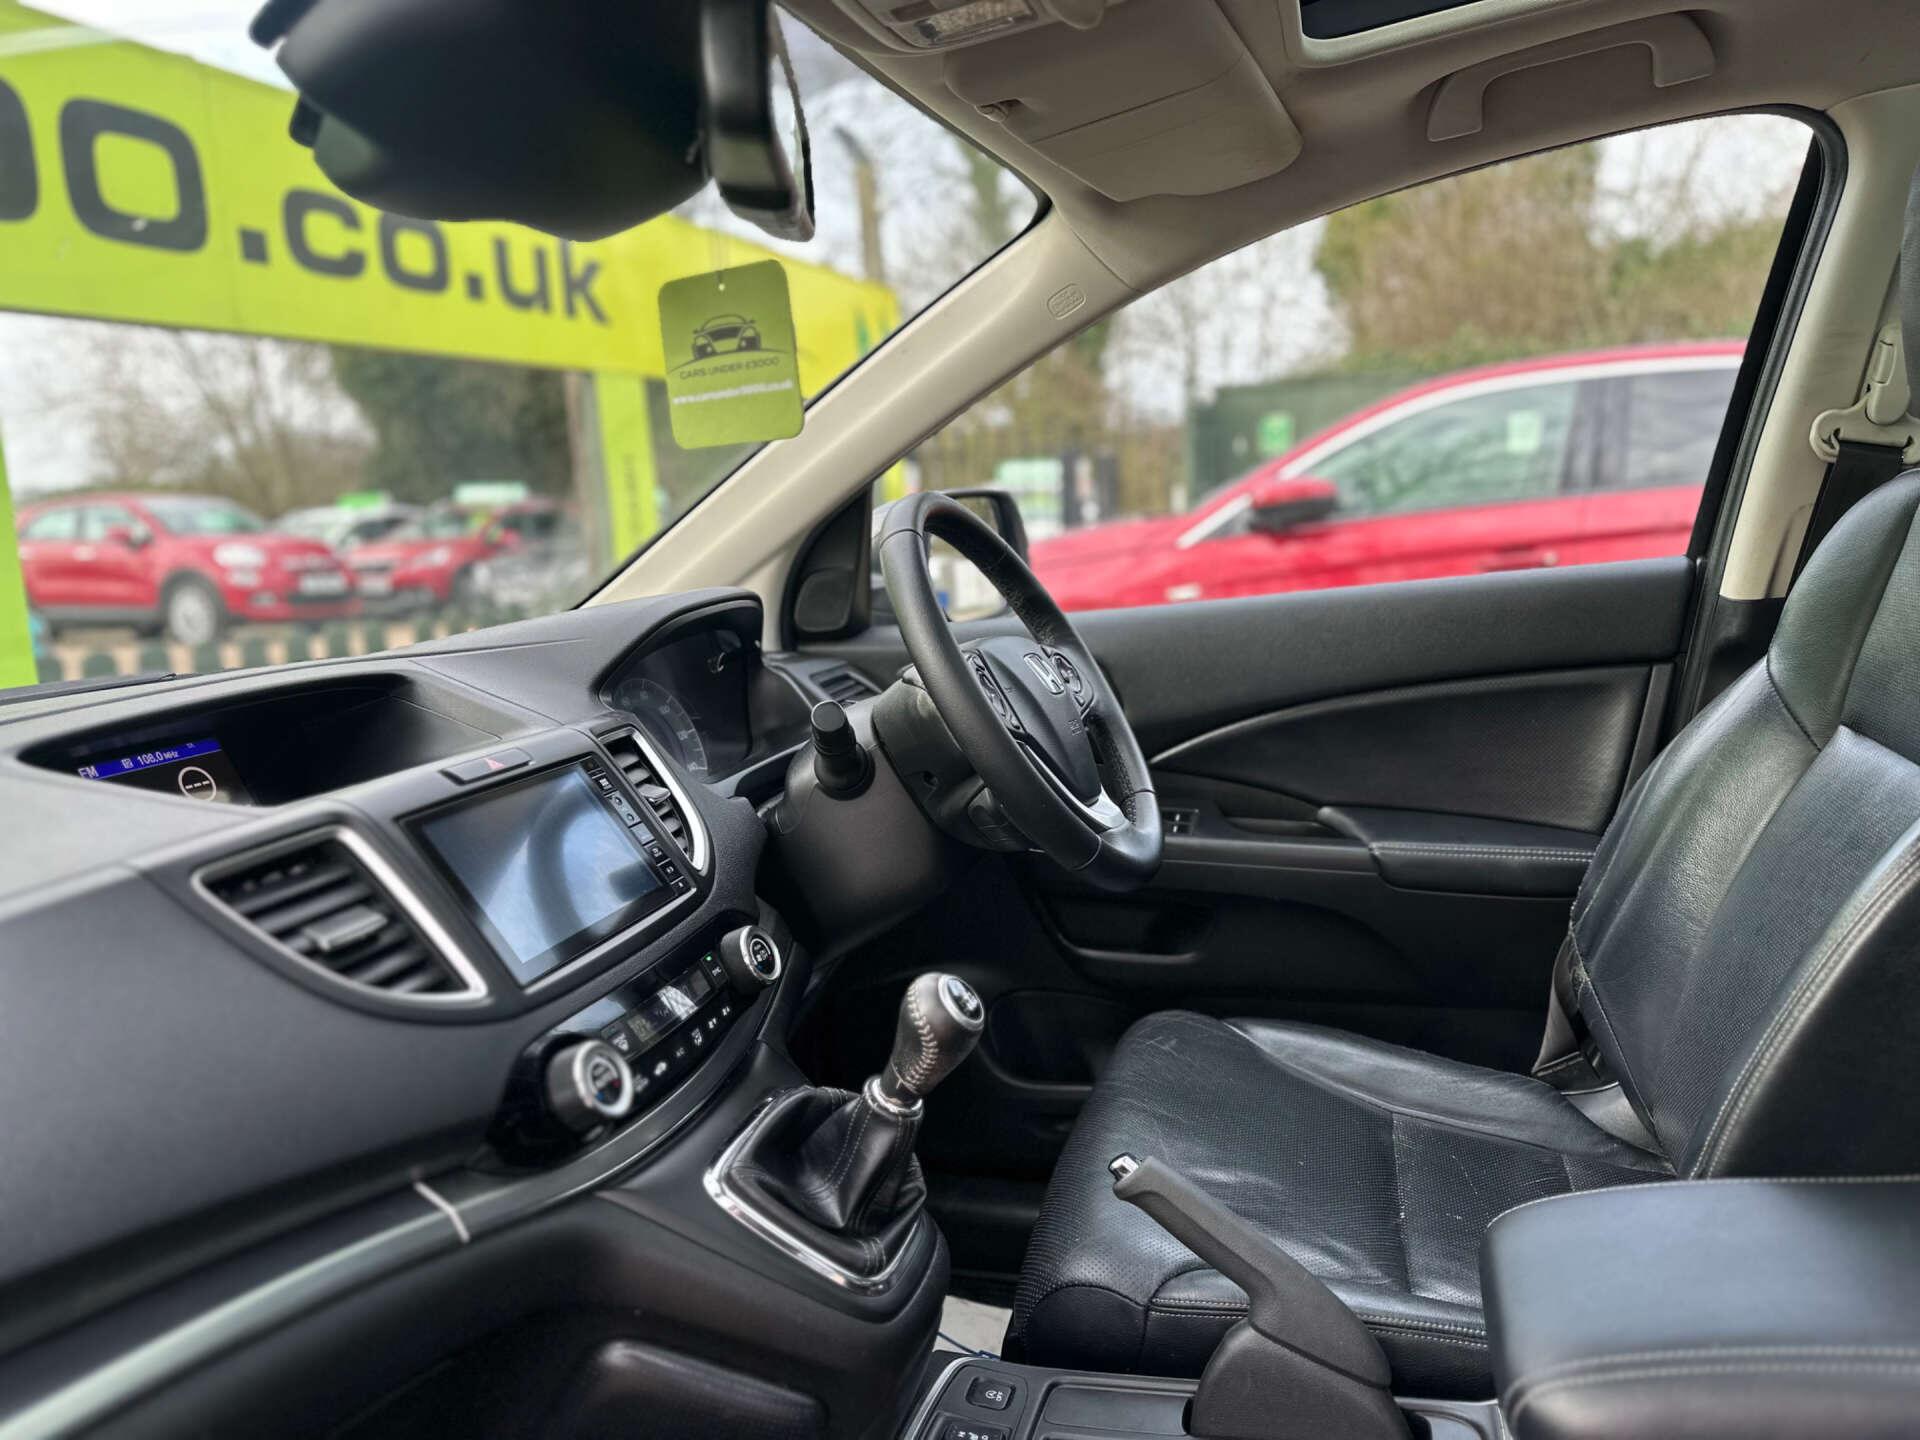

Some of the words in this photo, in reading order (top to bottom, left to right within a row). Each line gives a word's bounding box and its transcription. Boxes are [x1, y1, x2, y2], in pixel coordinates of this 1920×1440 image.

[680, 367, 705, 380] CARS
[708, 363, 744, 376] UNDER
[78, 766, 98, 779] FM
[137, 752, 163, 766] 108.0
[163, 750, 179, 760] MHz
